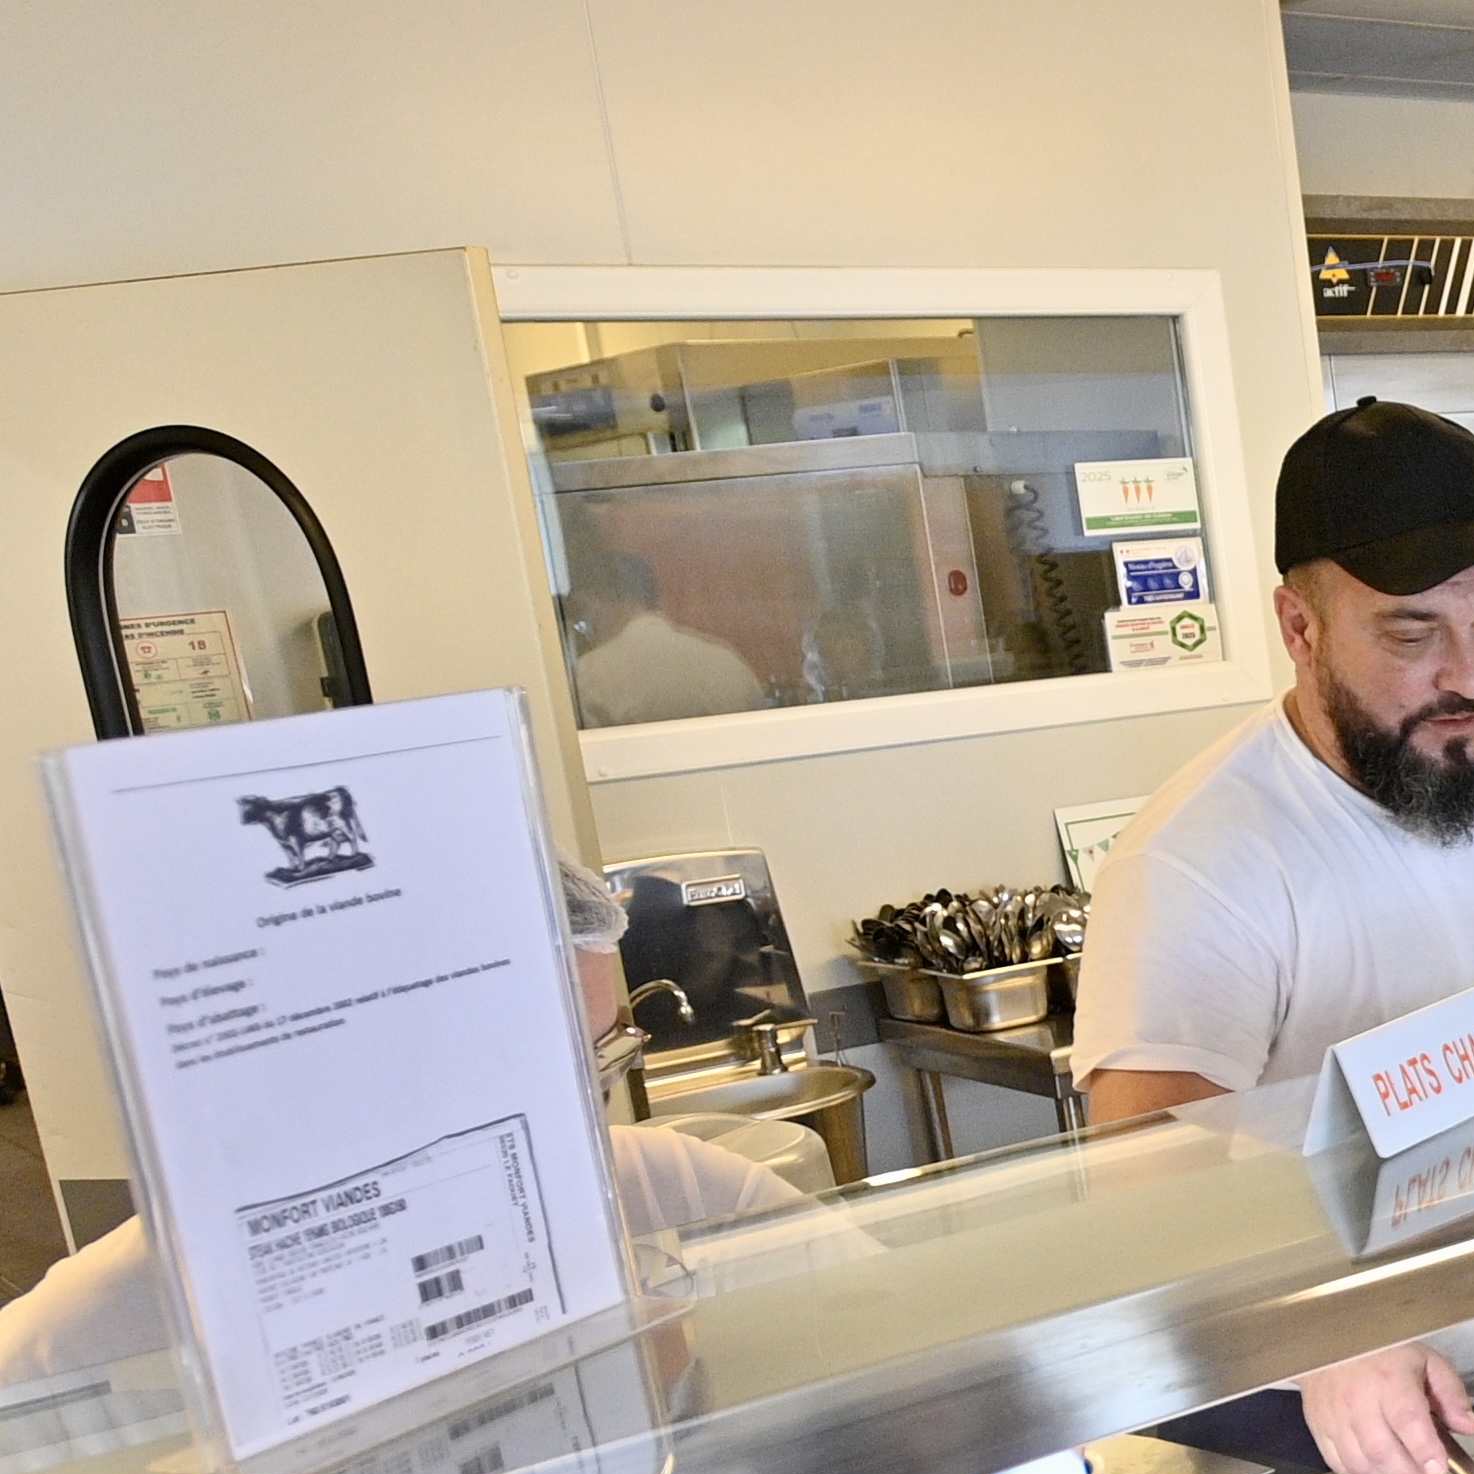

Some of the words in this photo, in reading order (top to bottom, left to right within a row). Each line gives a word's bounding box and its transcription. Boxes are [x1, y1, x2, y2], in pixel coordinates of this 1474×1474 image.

[1080, 471, 1112, 482] 2025
[145, 618, 196, 629] D'URGENCE
[188, 640, 207, 651] 18
[256, 911, 297, 928] Origine
[300, 907, 314, 919] de
[315, 904, 327, 915] la
[329, 896, 364, 912] viande
[365, 888, 402, 904] bovine
[1372, 1052, 1442, 1117] PLATS
[248, 1199, 319, 1236] MONFORT
[320, 1180, 381, 1212] VIANDES
